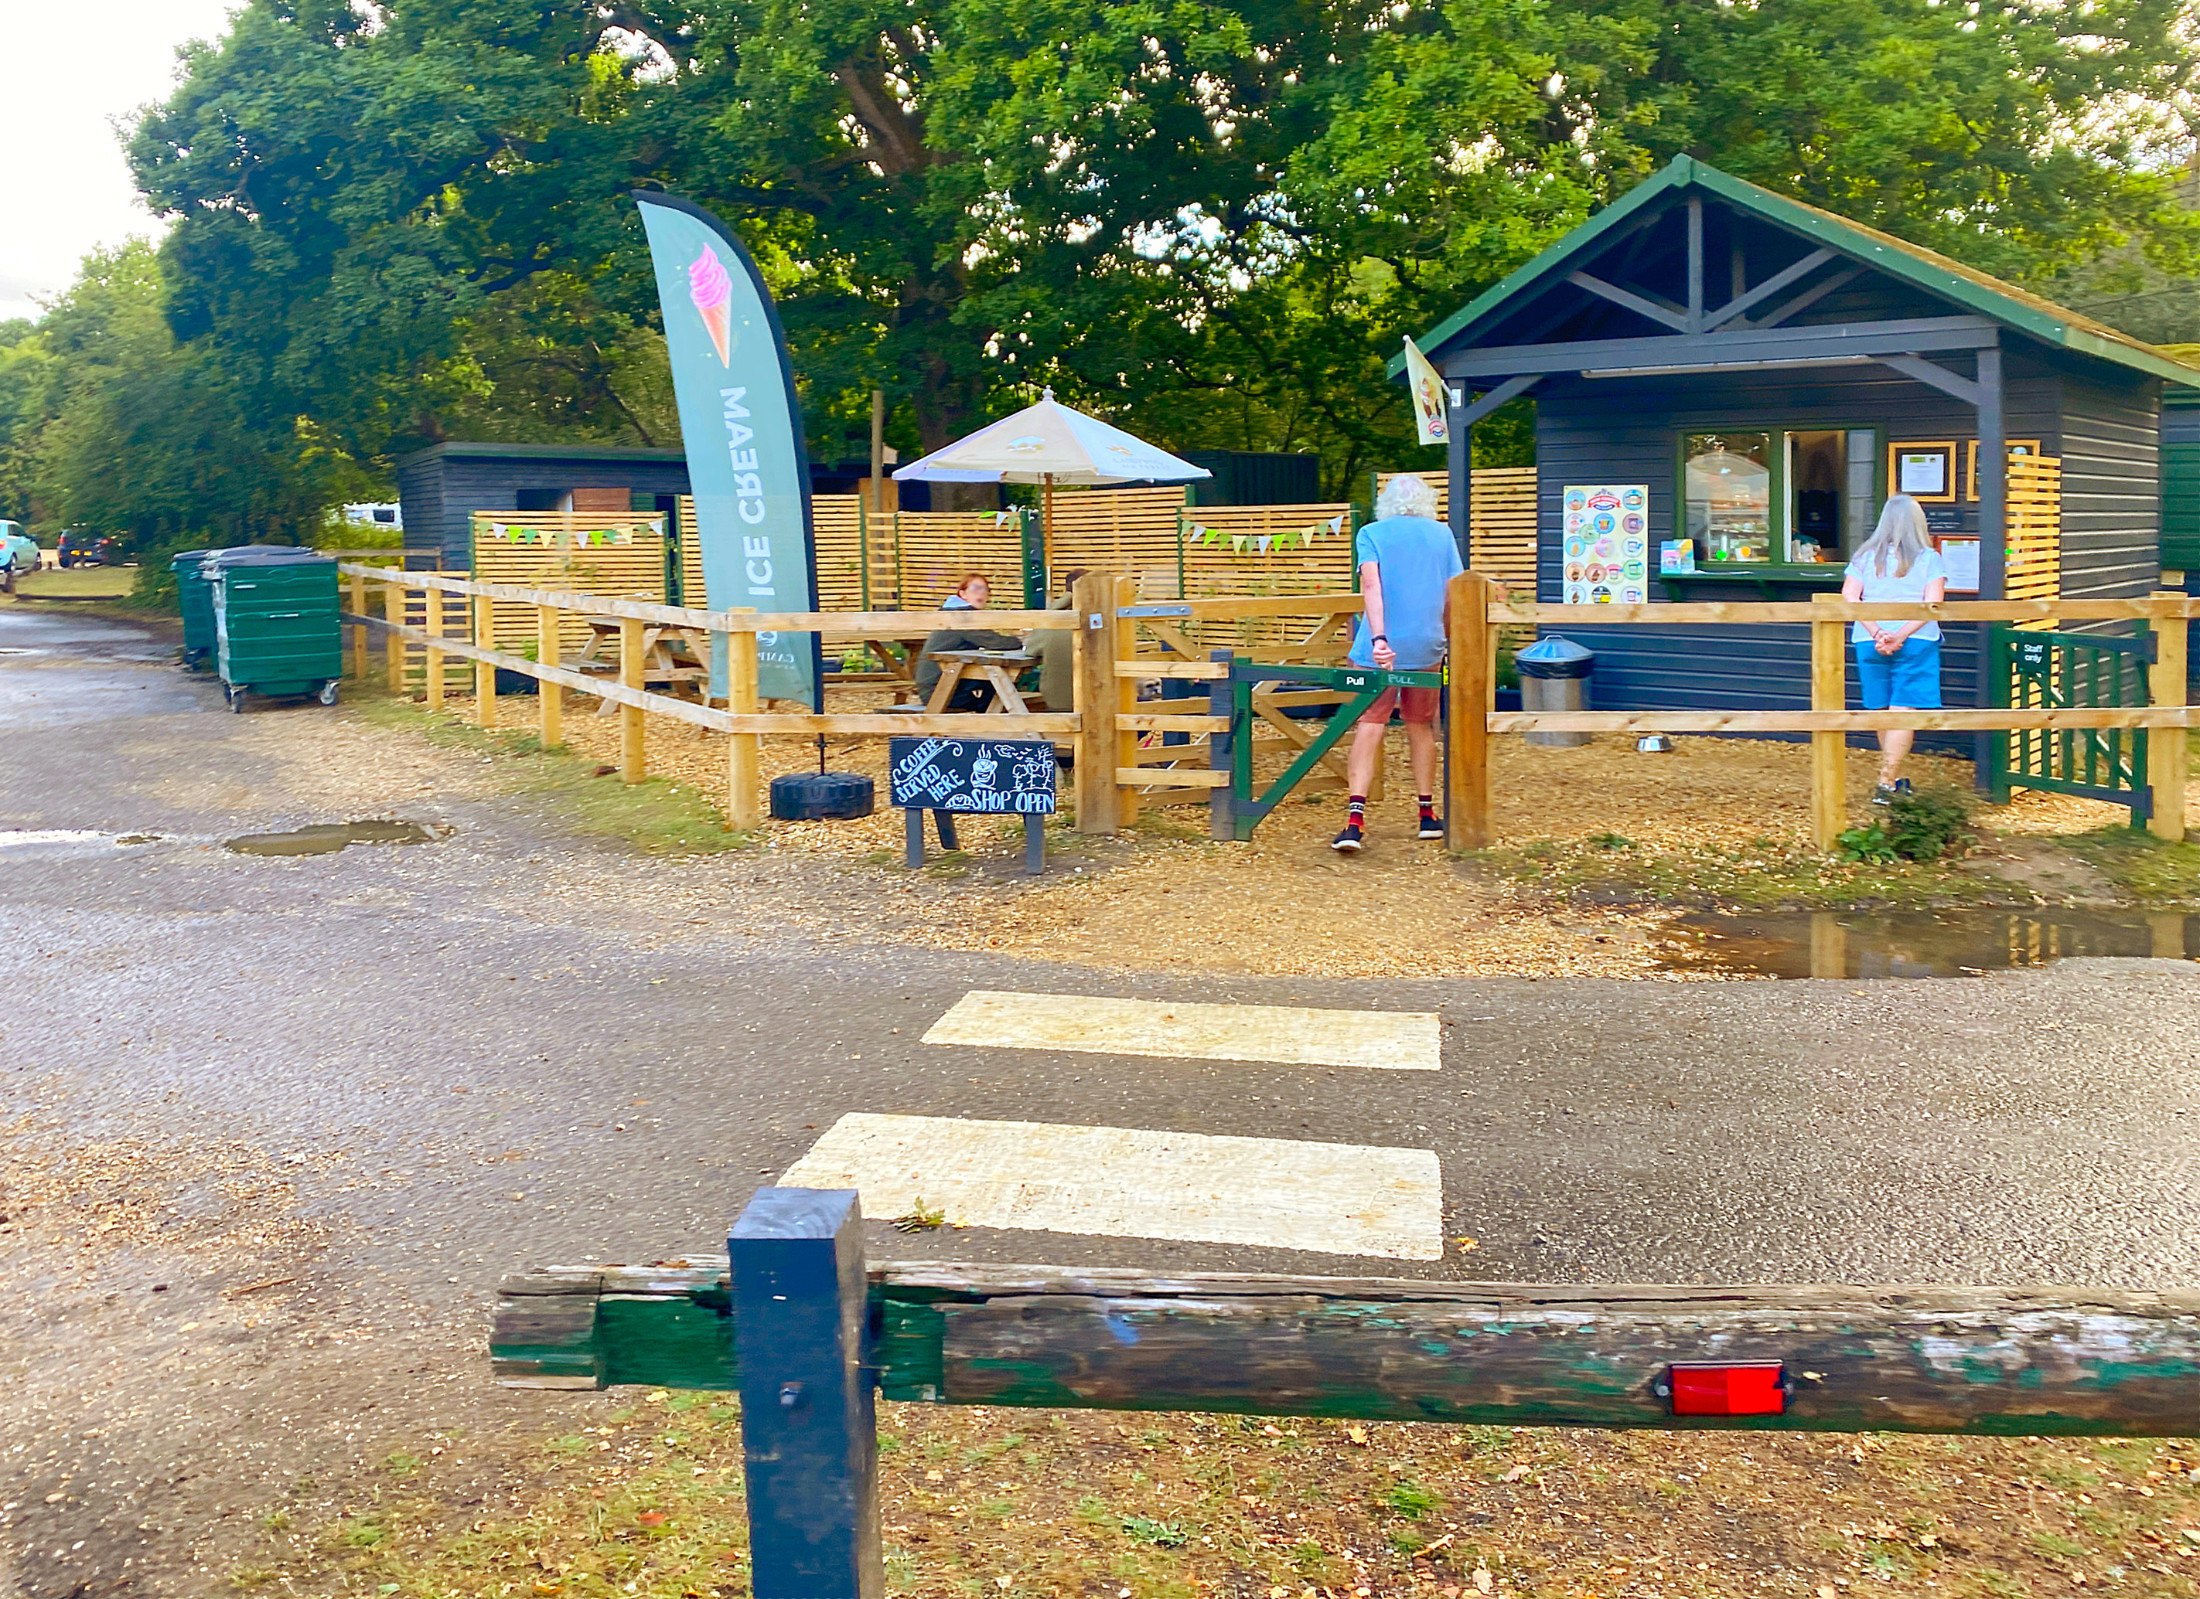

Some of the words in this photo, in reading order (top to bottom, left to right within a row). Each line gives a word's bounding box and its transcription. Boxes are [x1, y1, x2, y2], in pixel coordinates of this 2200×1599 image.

[2023, 643, 2043, 653] Staff
[2024, 654, 2042, 664] only
[1346, 676, 1365, 686] Pull
[1387, 673, 1416, 685] PULL
[896, 764, 941, 803] SERVED
[927, 769, 966, 802] HERE
[971, 789, 1012, 812] SHOP
[1015, 791, 1055, 813] OPEN
